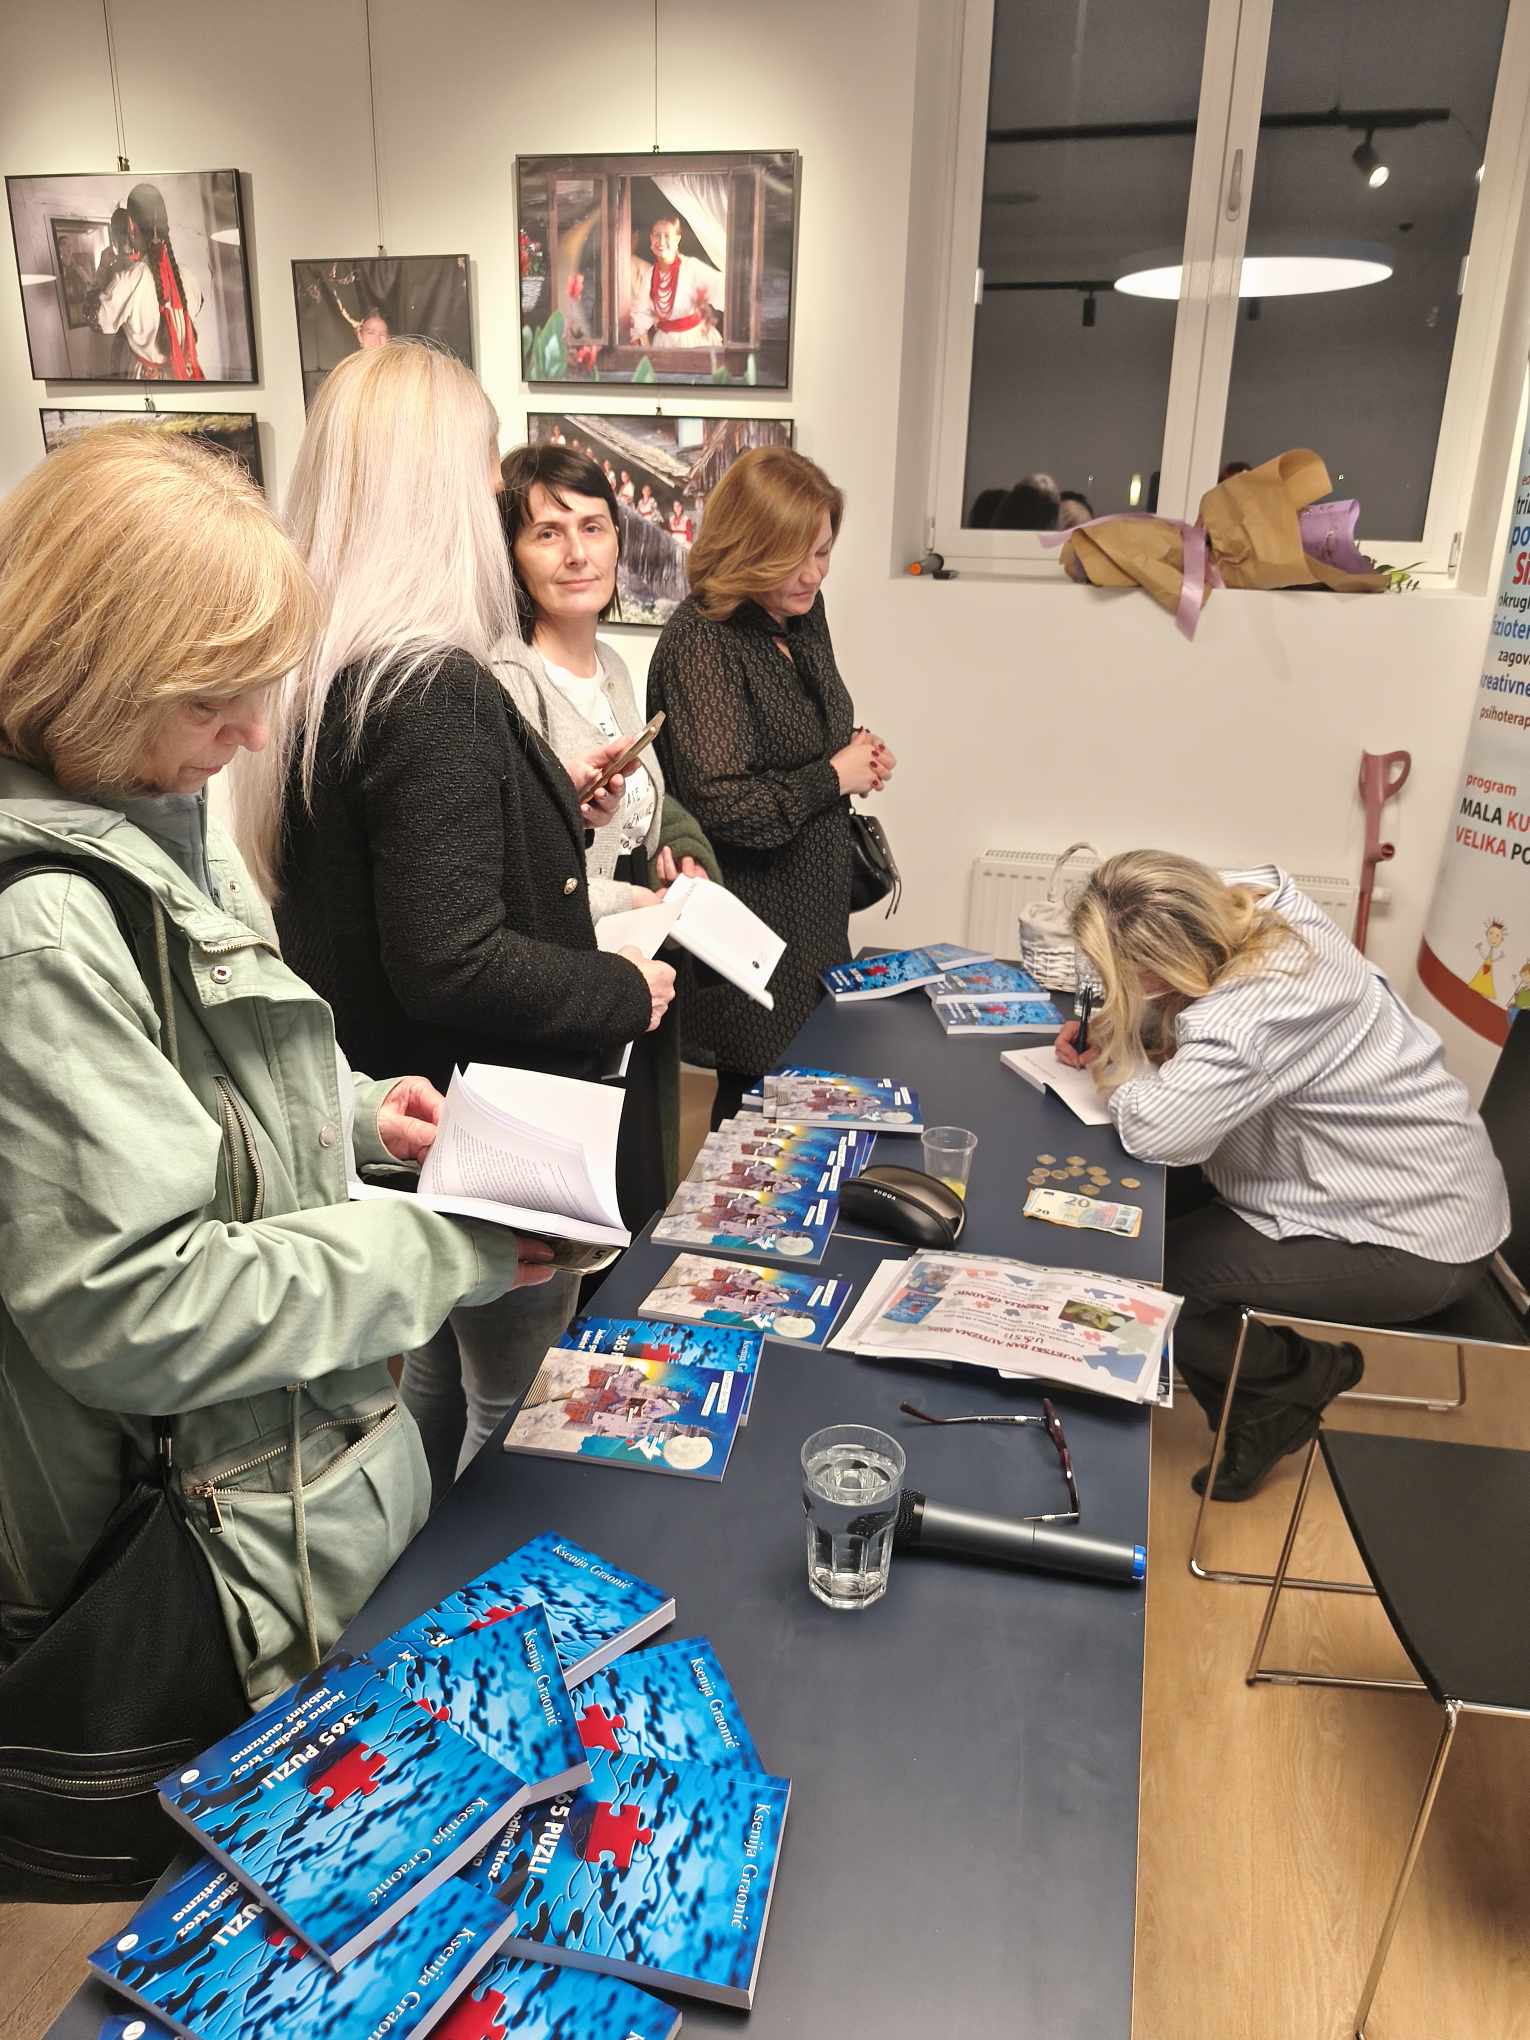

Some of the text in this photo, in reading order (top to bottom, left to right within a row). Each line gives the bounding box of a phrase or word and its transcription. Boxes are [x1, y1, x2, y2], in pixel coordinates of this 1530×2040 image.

[1516, 493, 1530, 514] tri
[1498, 651, 1530, 667] zagov
[1466, 775, 1517, 796] program
[1460, 797, 1502, 825] MALA
[1456, 825, 1506, 857] VELIKA
[1064, 1196, 1090, 1208] 20
[613, 1335, 630, 1352] 365
[552, 1544, 633, 1590] Ksenija Graonić
[523, 1628, 563, 1727] Ksenija Graonić
[230, 1687, 331, 1763] labirint autizma
[308, 1690, 347, 1721] Jedna
[690, 1657, 740, 1749] Ksenija Graonić
[260, 1713, 361, 1790] 365 PUZLI
[262, 1719, 307, 1756] godina
[232, 1754, 264, 1777] kroz
[431, 1797, 489, 1847] Ksenija
[488, 1809, 522, 1879] odina kroz
[528, 1791, 575, 1875] 65 PUZLI
[367, 1848, 433, 1905] Graonić
[731, 1802, 771, 1931] Ksenija Graonić
[171, 1872, 228, 1922] autizma
[176, 1881, 239, 1937] dina kroz
[212, 1902, 265, 1946] UZLI
[367, 1927, 478, 2040] Ksenija Graon
